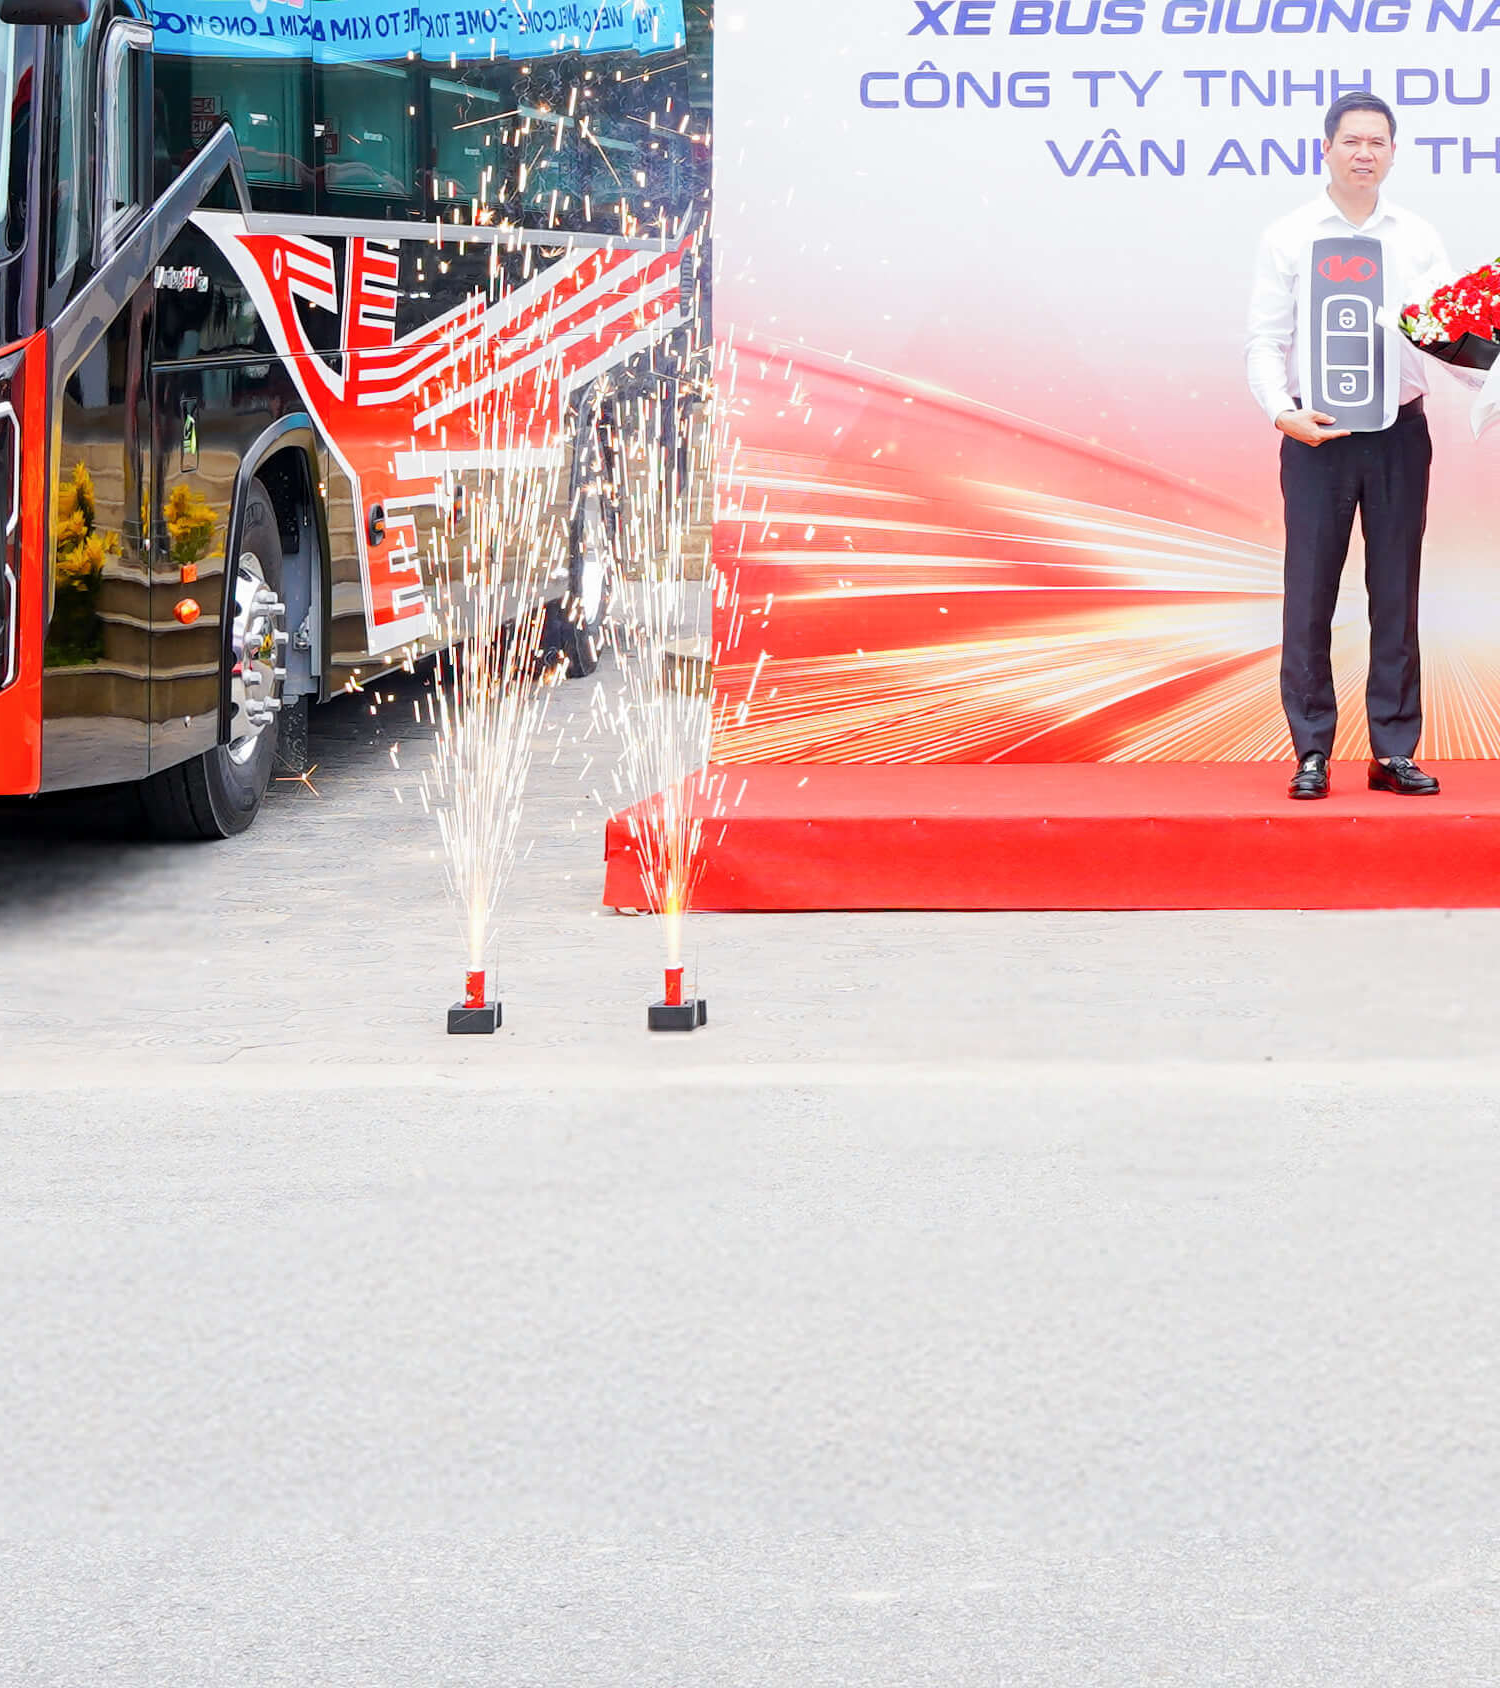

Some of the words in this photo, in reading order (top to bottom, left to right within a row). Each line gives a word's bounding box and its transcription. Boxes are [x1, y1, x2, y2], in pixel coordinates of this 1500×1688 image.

[907, 0, 997, 36] XE
[1009, 0, 1146, 36] BUS
[859, 60, 1051, 109] CÔNG
[1072, 70, 1163, 108] TY
[1184, 69, 1372, 107] TNHH
[1395, 68, 1490, 106] DU
[1046, 128, 1185, 177] VÂN
